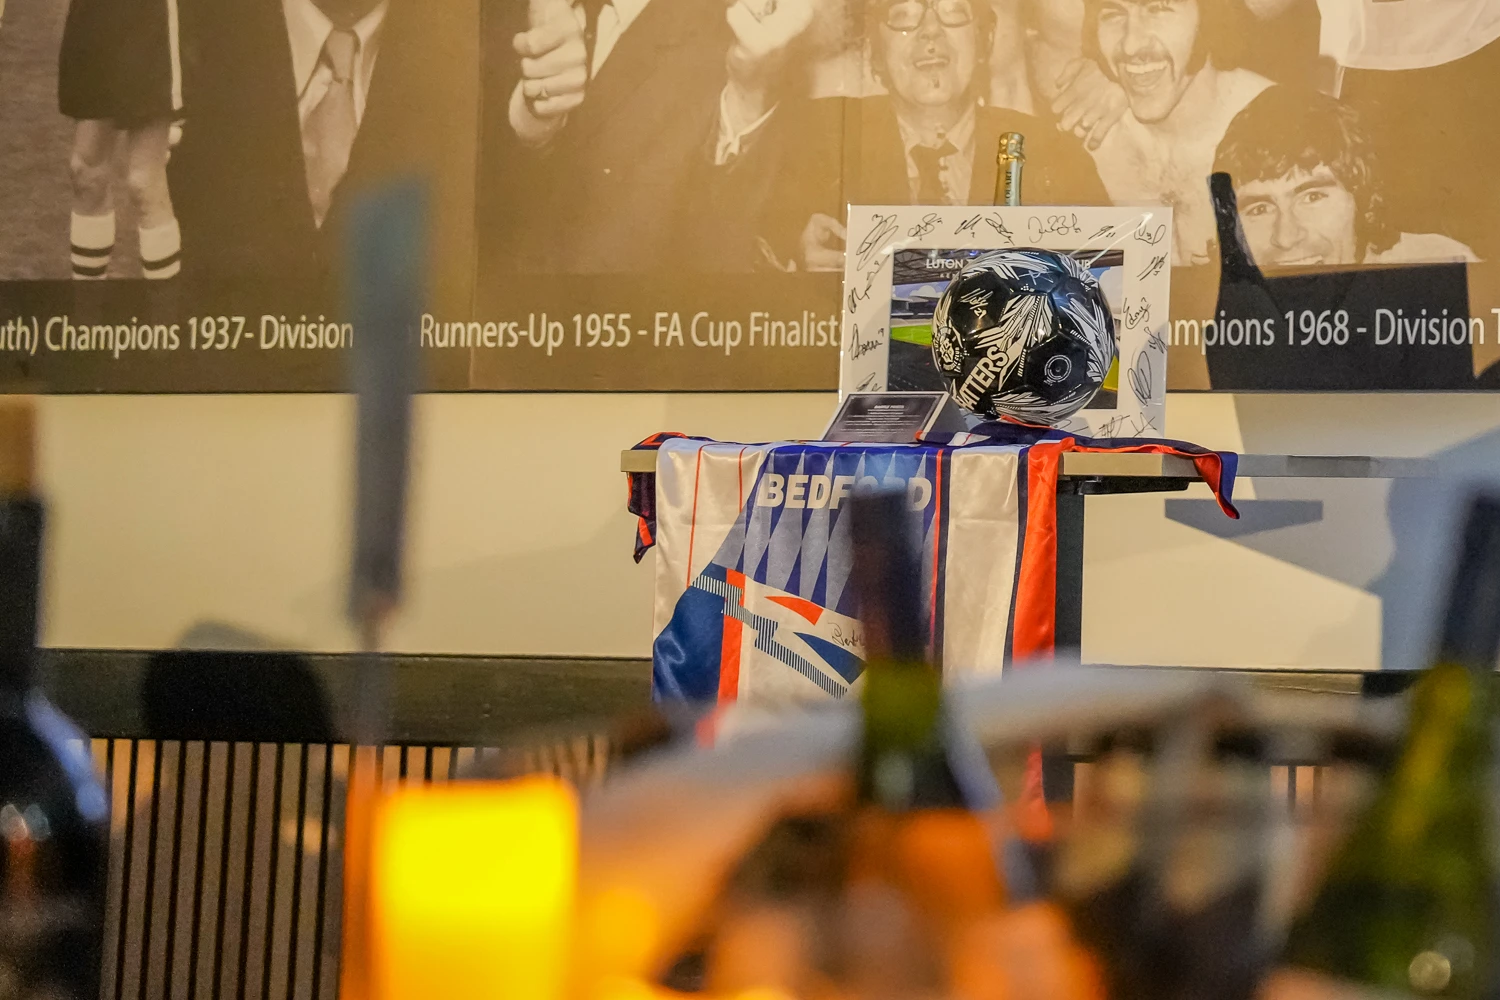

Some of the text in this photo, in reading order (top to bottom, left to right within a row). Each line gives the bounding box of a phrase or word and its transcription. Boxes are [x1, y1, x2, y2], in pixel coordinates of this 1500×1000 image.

[926, 259, 964, 269] LUTON
[45, 314, 180, 360] Champions
[260, 314, 354, 350] Division
[420, 312, 564, 357] Runners-Up
[572, 312, 631, 348] 1955
[653, 311, 684, 348] FA
[690, 310, 742, 356] Cup
[1284, 308, 1350, 346] 1968
[1374, 308, 1485, 346] Division
